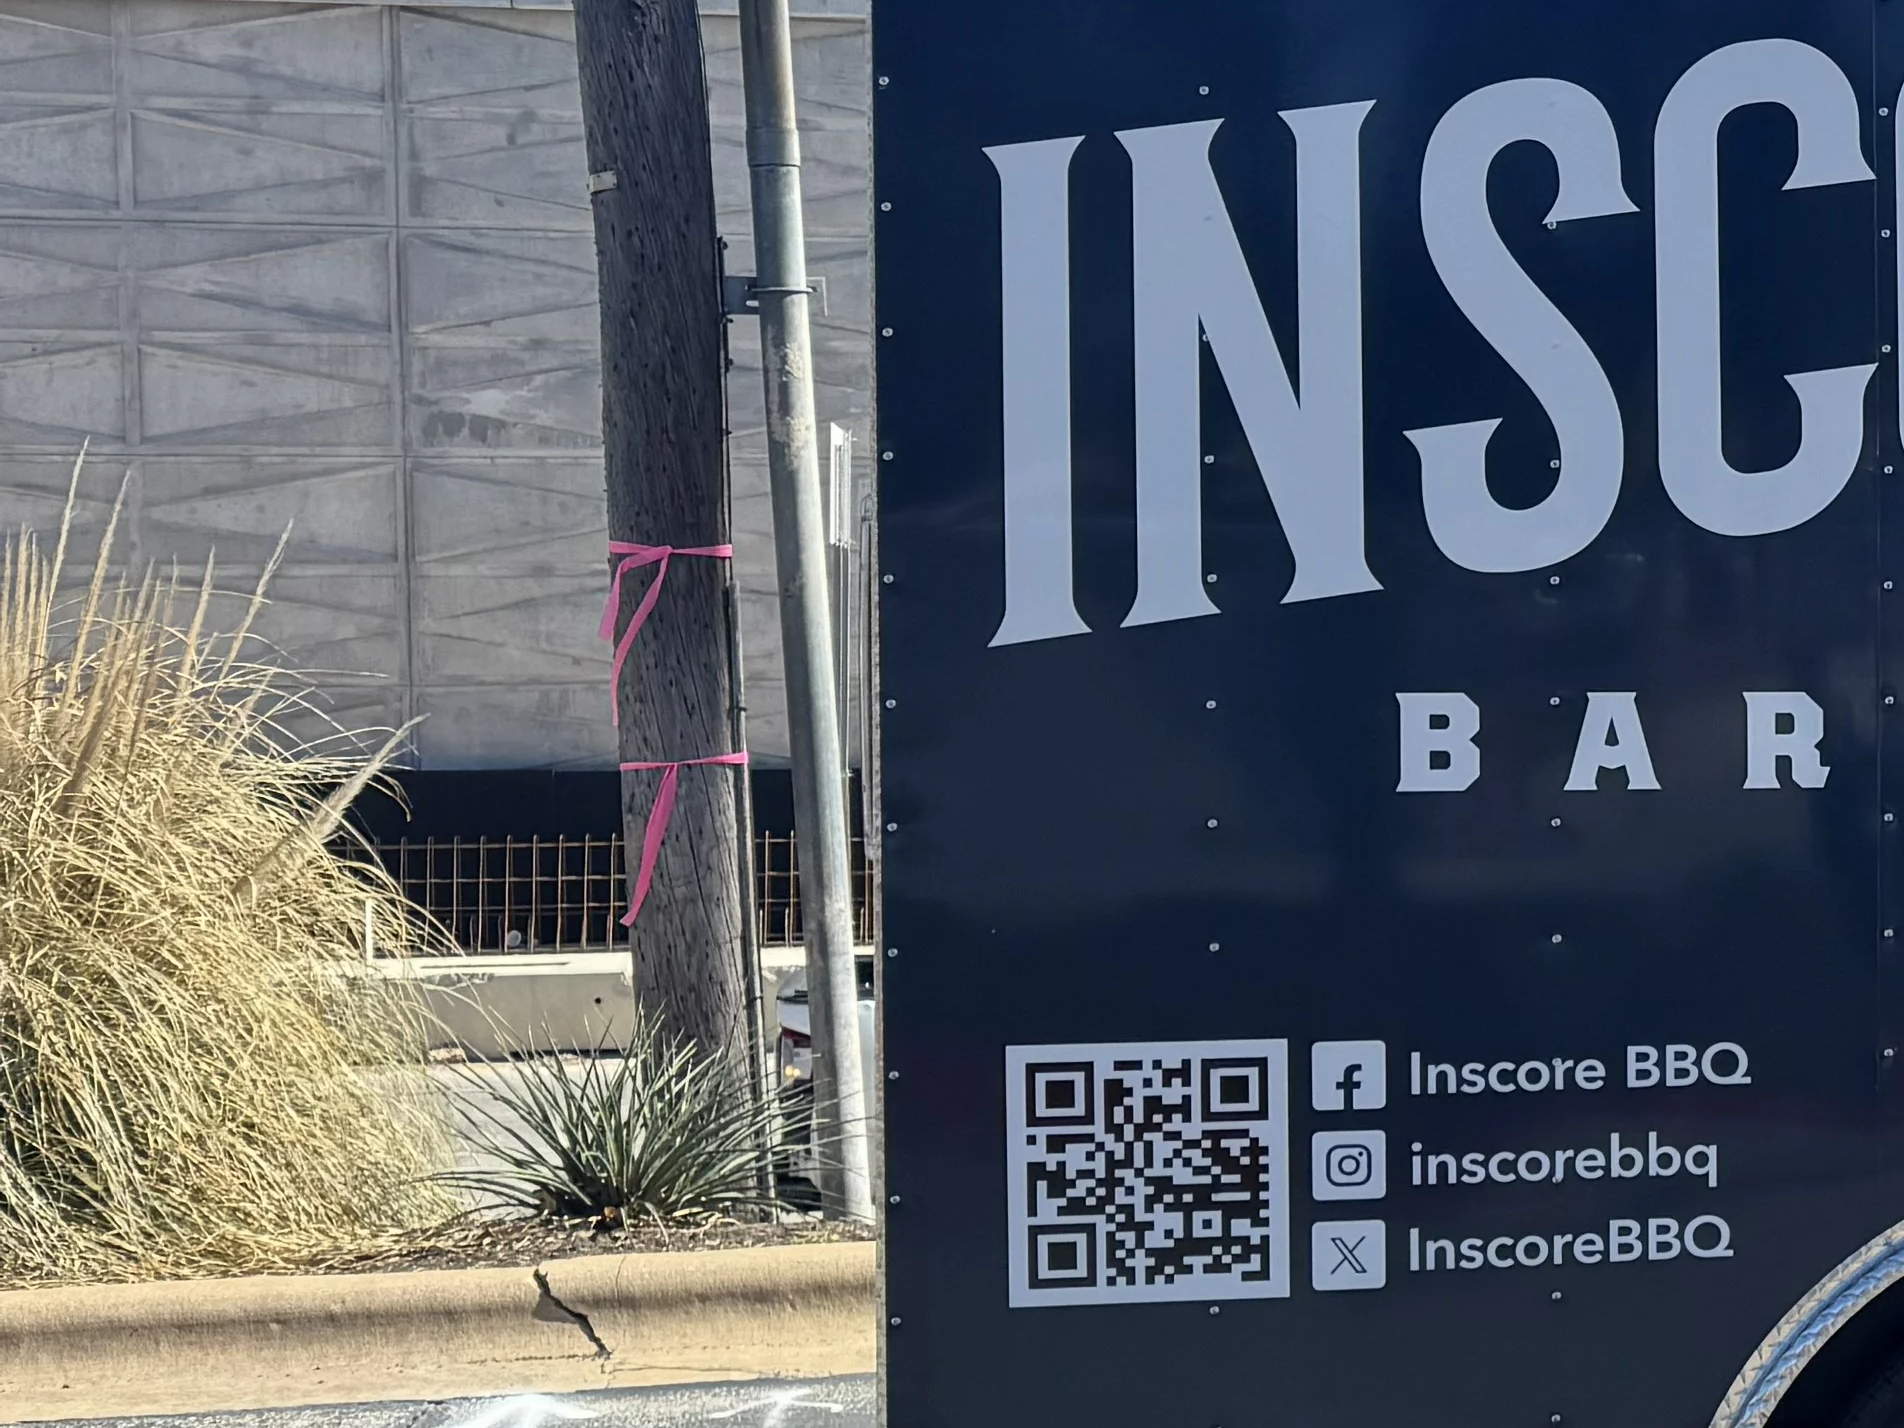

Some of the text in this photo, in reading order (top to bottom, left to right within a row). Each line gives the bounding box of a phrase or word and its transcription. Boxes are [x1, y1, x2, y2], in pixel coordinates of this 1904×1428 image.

[1409, 1050, 1607, 1095] Inscore
[1626, 1042, 1753, 1088] BBQ
[1410, 1131, 1719, 1188] inscorebbq
[1409, 1215, 1735, 1271] InscoreBBQ
